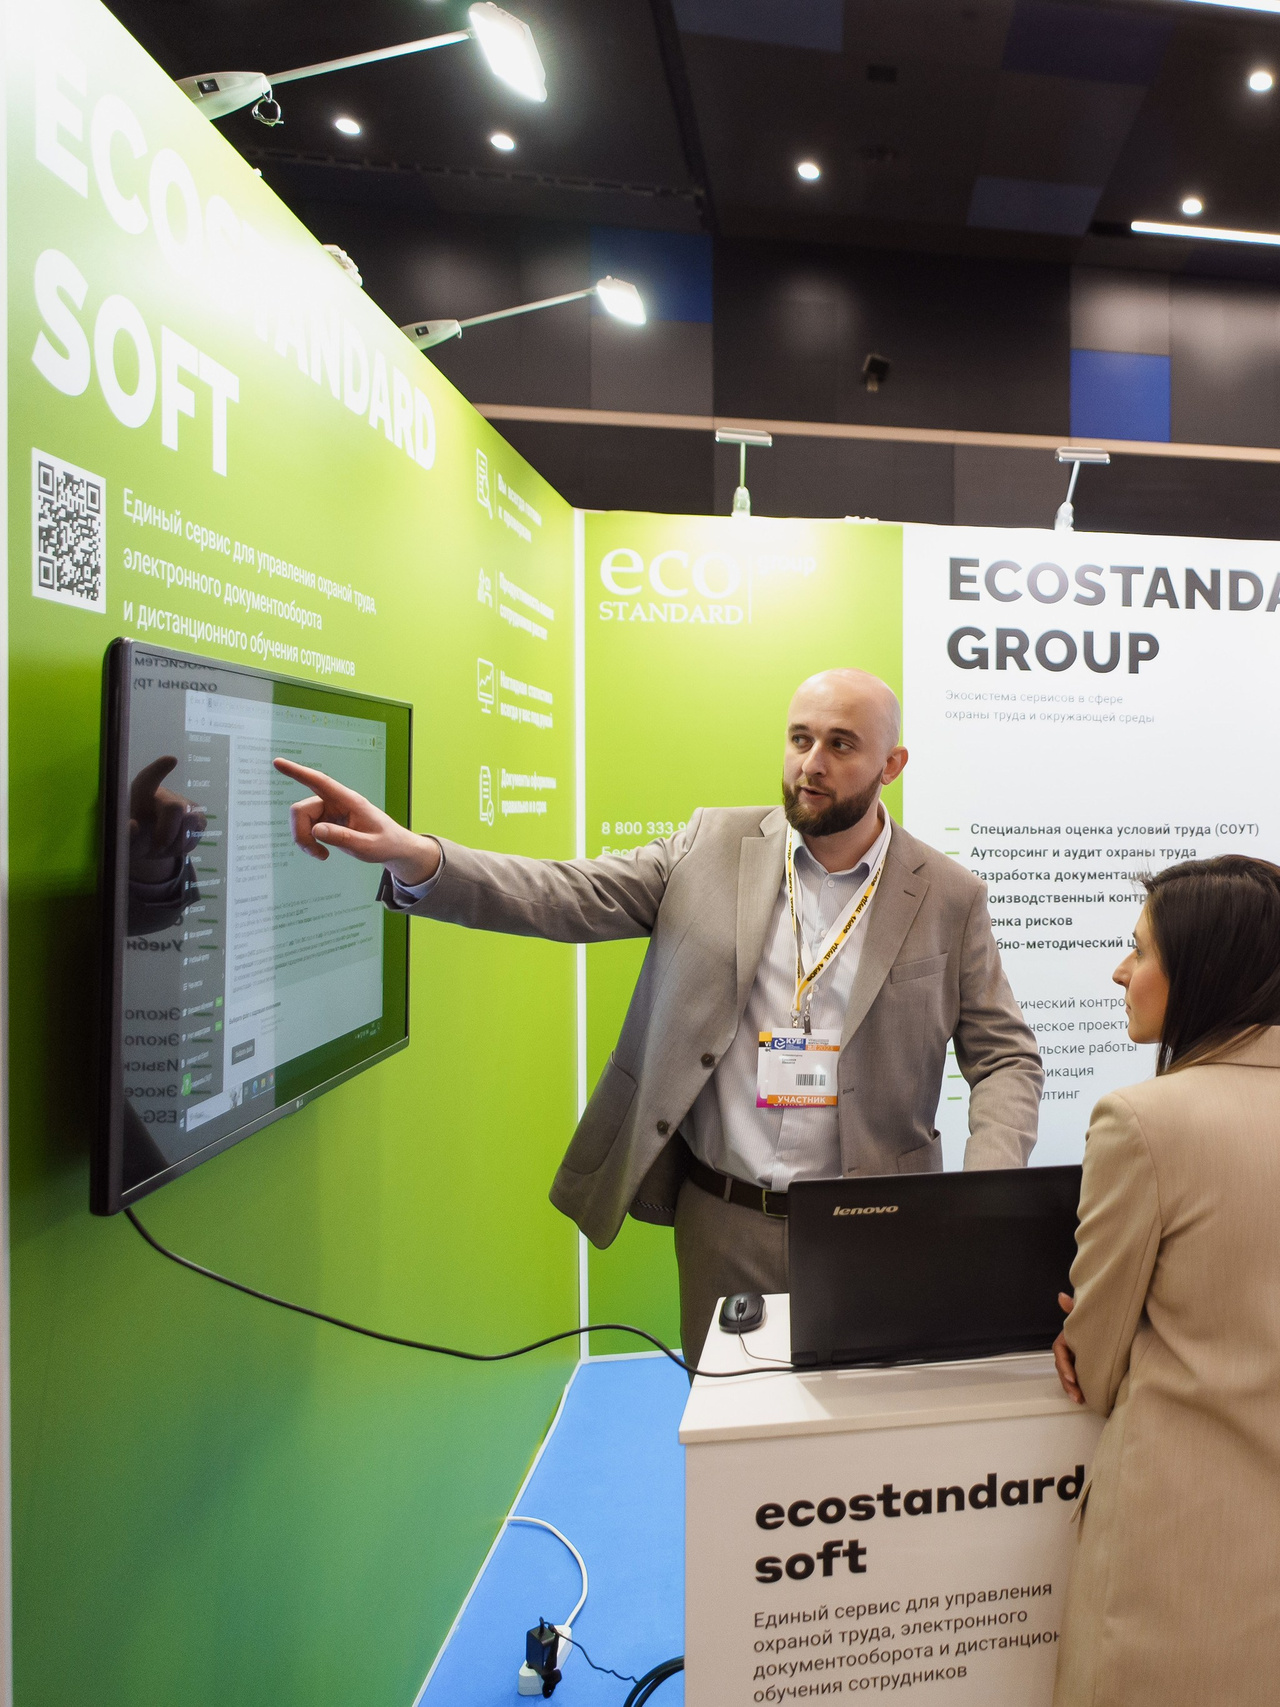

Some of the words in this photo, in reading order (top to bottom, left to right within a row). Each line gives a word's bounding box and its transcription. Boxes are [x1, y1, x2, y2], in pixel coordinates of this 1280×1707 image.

[32, 249, 240, 477] SOFT
[123, 488, 182, 536] Единый
[185, 521, 231, 555] сервис
[233, 541, 255, 565] для
[257, 550, 316, 588] управления
[317, 575, 353, 604] охраной
[354, 590, 377, 615] труда,
[600, 548, 742, 599] eco
[123, 547, 222, 598] электронного
[224, 583, 323, 630] документооборота
[599, 601, 744, 625] STANDARD
[123, 600, 133, 622] и
[137, 605, 248, 650] дистанционного
[250, 632, 298, 664] обучения
[300, 649, 356, 677] сотрудников
[946, 626, 1160, 674] GROUP
[945, 690, 1017, 702] Экосистема
[1020, 693, 1075, 705] сервисов
[1078, 695, 1085, 703] в
[1088, 693, 1123, 705] сфере
[945, 709, 990, 721] охраны
[993, 711, 1026, 722] труда
[1029, 712, 1036, 720] и
[1039, 711, 1116, 723] окружающей
[1119, 713, 1155, 724] среды
[602, 821, 611, 835] 8
[615, 821, 643, 835] 800
[646, 821, 674, 835] 333
[970, 823, 1061, 837] Специальная
[1065, 825, 1113, 837] оценка
[1117, 823, 1171, 838] условий
[1174, 826, 1211, 837] труда
[1215, 823, 1259, 837] (СОУТ)
[970, 847, 1049, 860] Аутсорсинг
[1052, 849, 1060, 857] и
[1064, 849, 1102, 860] аудит
[1106, 848, 1156, 860] охраны
[1159, 848, 1197, 860] труда
[987, 891, 1105, 905] оизводственный
[1109, 893, 1148, 905] контр
[990, 918, 1022, 927] енка
[1025, 916, 1073, 929] рисков
[996, 936, 1123, 950] бно-методический
[1079, 998, 1126, 1010] контро
[1028, 1021, 1075, 1033] ческое
[1038, 1044, 1085, 1055] льские
[1088, 1041, 1138, 1055] работы
[777, 1095, 826, 1104] УЧАСТНИК
[1041, 1090, 1080, 1101] лтинг
[833, 1204, 899, 1216] lenovo
[755, 1464, 1086, 1530] ecostandard
[755, 1539, 868, 1583] soft
[754, 1605, 829, 1629] Единый
[834, 1598, 901, 1620] сервис
[905, 1595, 939, 1614] для
[945, 1583, 1052, 1610] управления
[753, 1629, 833, 1654] охраной
[838, 1625, 895, 1647] труда,
[901, 1609, 1028, 1637] электронного
[753, 1645, 934, 1681] документооборота
[939, 1644, 950, 1656] и
[954, 1631, 1060, 1656] дистанцион
[753, 1678, 843, 1703] обучения
[848, 1664, 968, 1691] сотрудников
